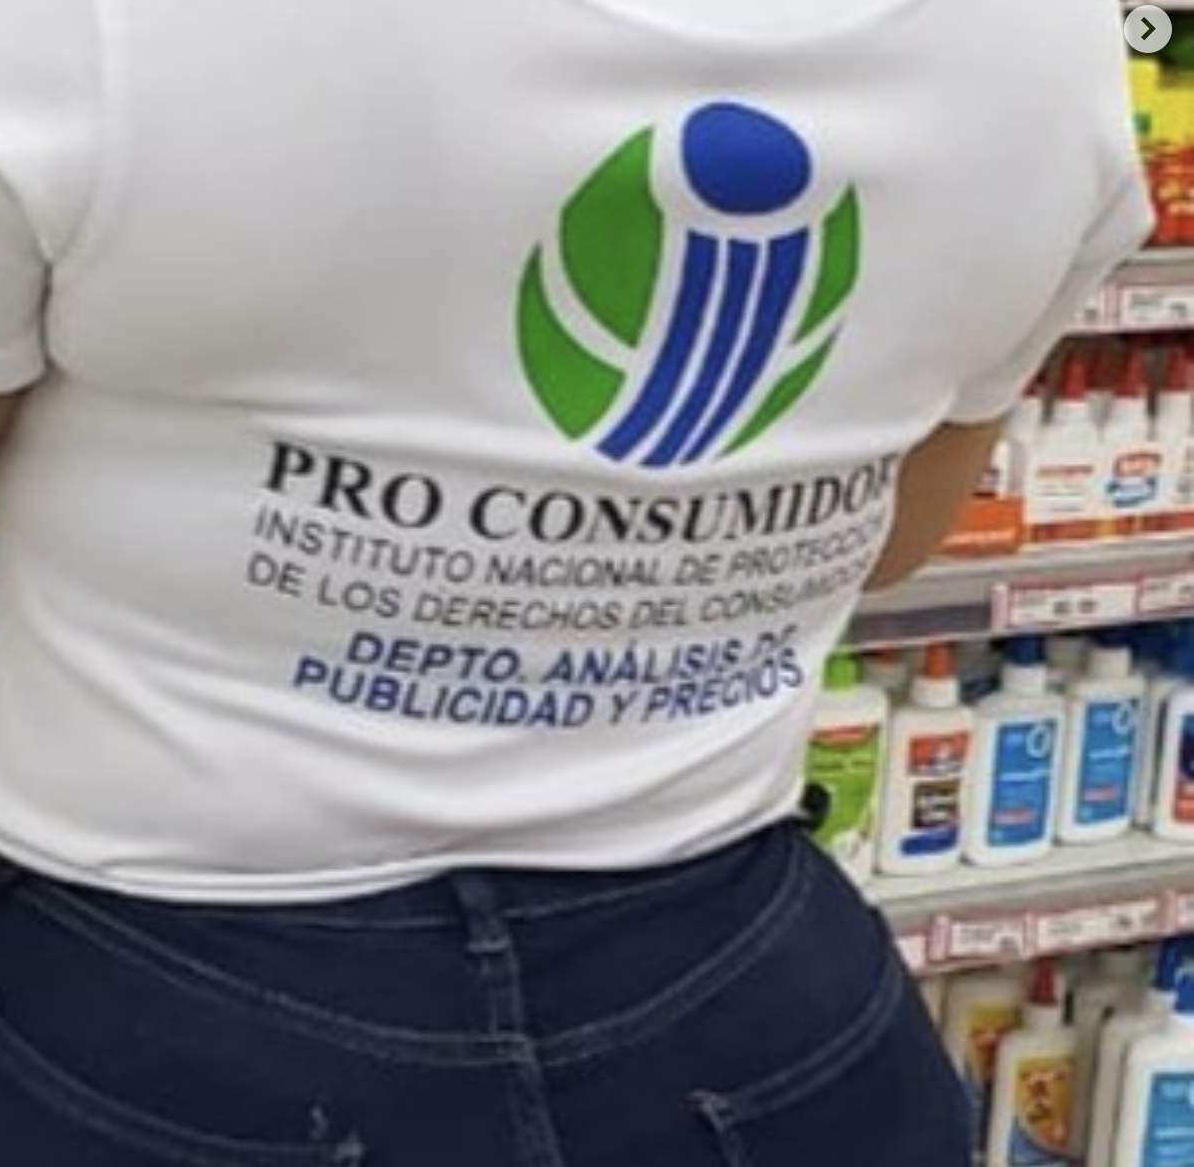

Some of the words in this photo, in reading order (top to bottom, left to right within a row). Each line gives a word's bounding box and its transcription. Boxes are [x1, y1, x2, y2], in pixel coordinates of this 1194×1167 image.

[264, 439, 445, 530] PRO
[254, 504, 475, 585] INSTITUTO
[484, 554, 662, 589] NACIONAL
[673, 553, 723, 587] DE
[246, 549, 306, 598] DE
[316, 574, 404, 620] LOS
[411, 591, 622, 631] DERECHOS
[627, 596, 687, 630] DEL
[292, 653, 595, 728] PUBLICIDAD
[608, 690, 640, 726] Y
[640, 644, 805, 724] PRECIOS
[345, 629, 527, 685] DEPTO.
[542, 637, 743, 685] ANÁLISIS
